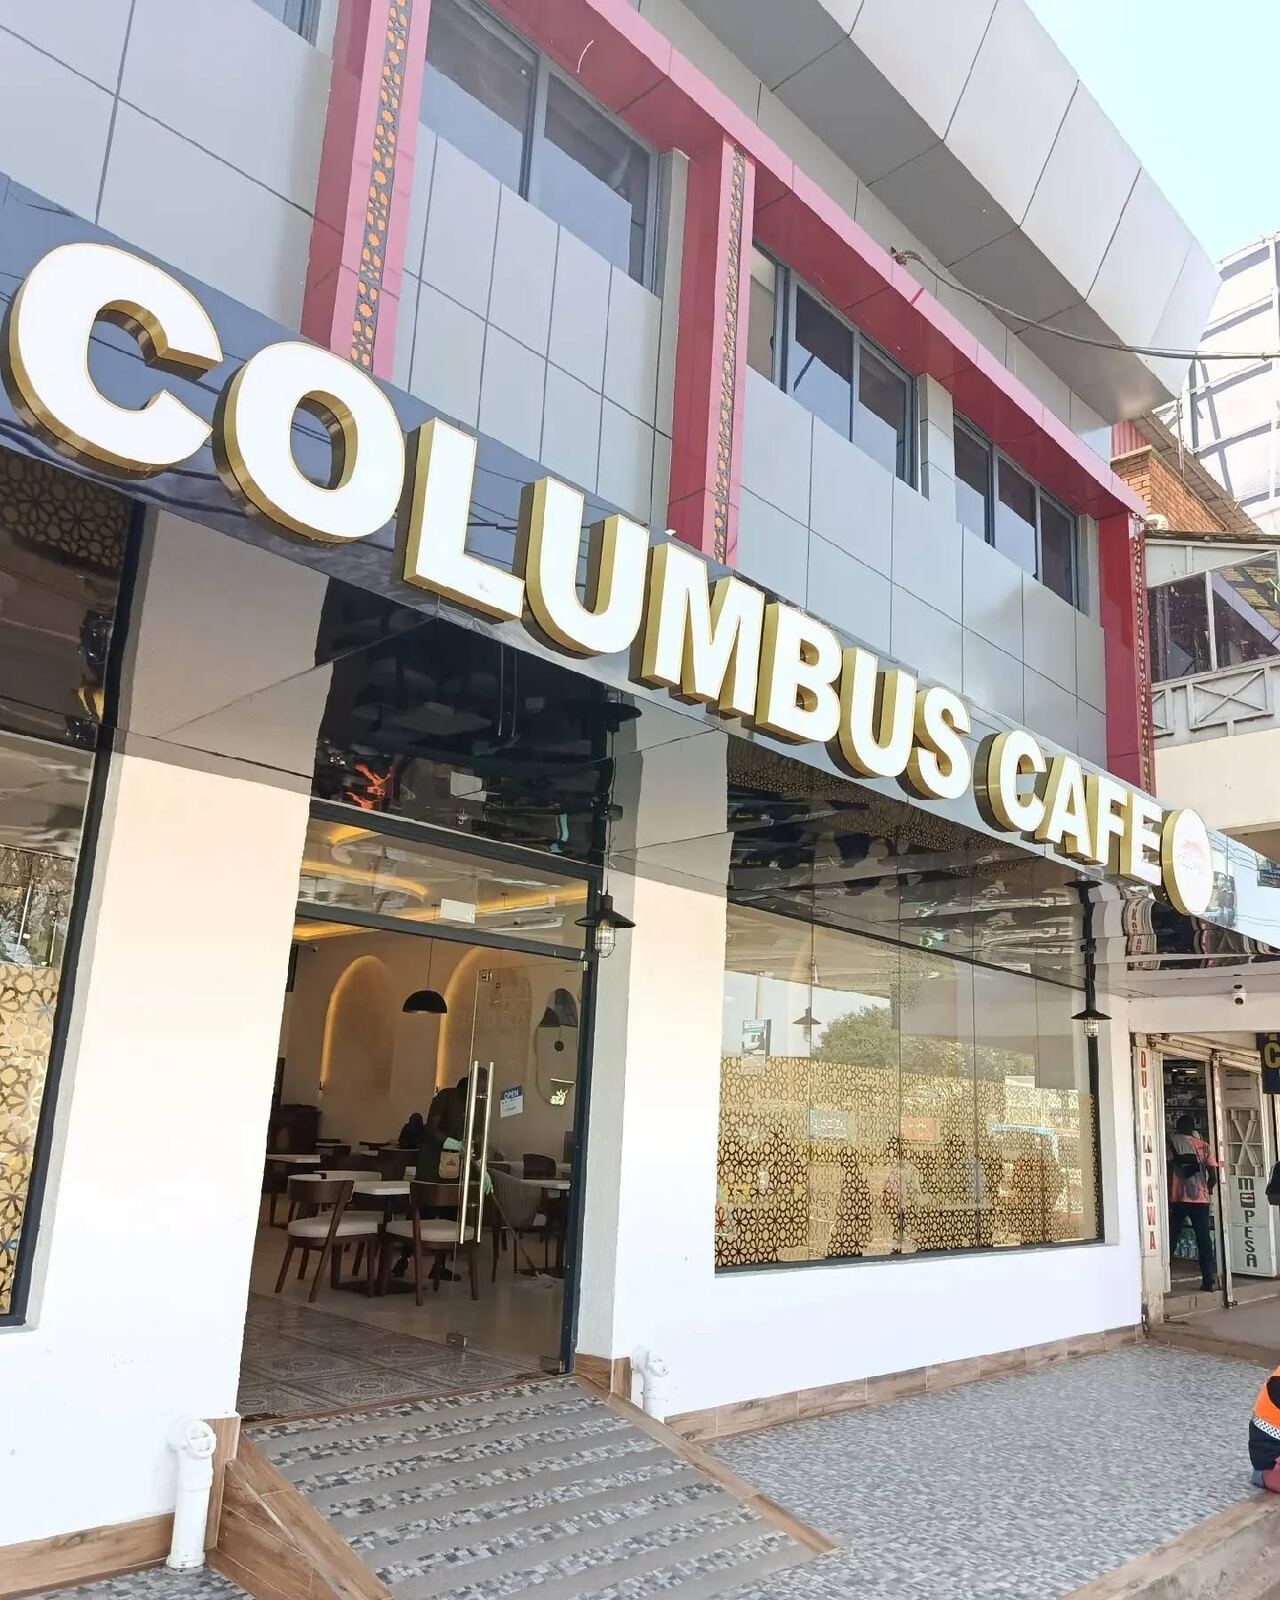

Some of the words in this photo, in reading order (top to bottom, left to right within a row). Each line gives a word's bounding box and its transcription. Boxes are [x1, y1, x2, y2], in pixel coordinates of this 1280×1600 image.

[8, 242, 971, 800] COLUMBUS
[984, 729, 1164, 886] CAFE
[503, 1089, 519, 1099] OPEN
